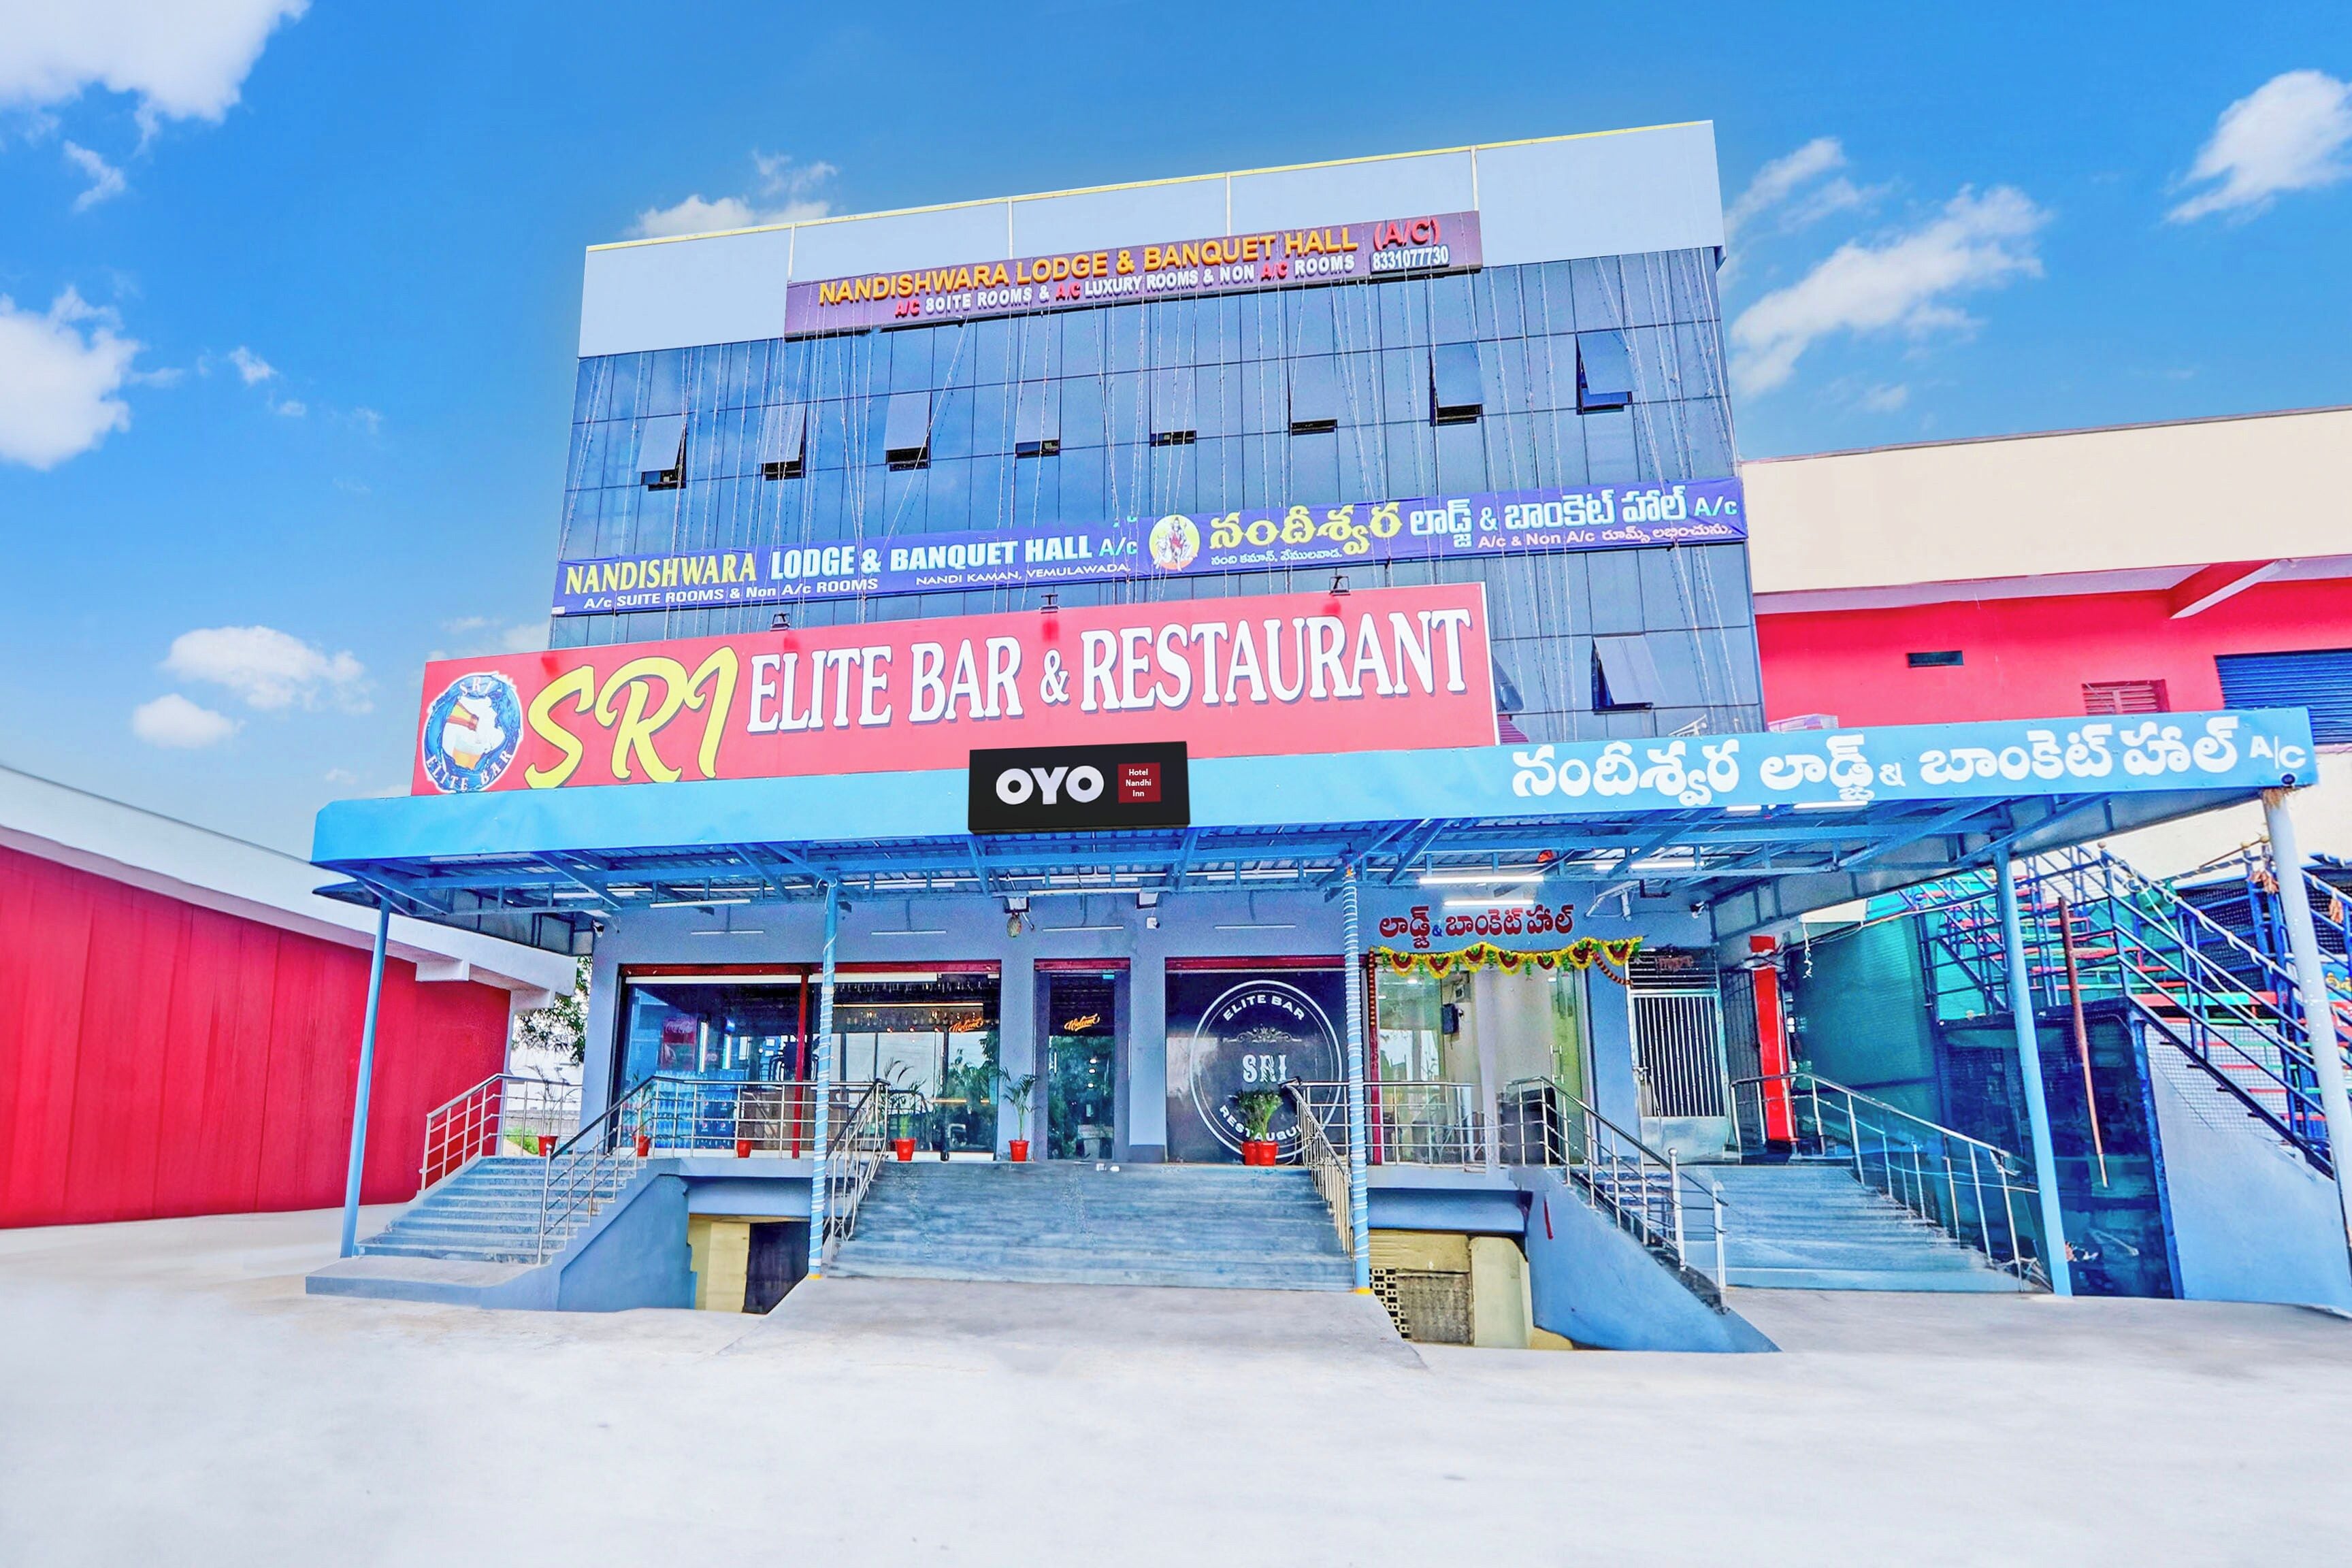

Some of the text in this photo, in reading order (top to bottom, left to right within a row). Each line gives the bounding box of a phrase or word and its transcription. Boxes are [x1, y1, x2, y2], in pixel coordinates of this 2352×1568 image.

[819, 218, 1441, 305] NANDISHWARA LODGE & BANQUET HALL (A/C)
[1373, 244, 1449, 271] 8331077730
[895, 300, 920, 318] A/C
[977, 283, 1032, 308] ROOMS
[1039, 282, 1049, 301] &
[1055, 281, 1081, 301] A/C
[1084, 274, 1143, 297] LUXURY
[1147, 268, 1198, 291] ROOMS
[1203, 267, 1214, 285] &
[1220, 263, 1254, 284] NON
[1261, 260, 1288, 280] A/C
[1294, 255, 1355, 278] ROOMS
[1209, 502, 1403, 555] నందీశ్వర
[1480, 506, 1499, 532] &
[1504, 489, 1616, 530] బాంకెట్
[1622, 485, 1688, 523] హాల్
[1693, 496, 1737, 517] A/c
[1477, 534, 1507, 549] A/c
[1510, 536, 1522, 546] &
[1526, 533, 1562, 546] Non
[1566, 529, 1595, 544] A/c
[565, 535, 1138, 595] NANDISHWARA LODGE & BANQUET HALL A/c
[916, 563, 1132, 586] NANDI KAMAN, VEMULAWADA.
[583, 577, 879, 609] A/c SUITE ROOMS & Non A/c ROOMS
[524, 608, 1472, 789] SRI ELITE BAR & RESTAURANT
[426, 750, 512, 791] ELITE BAR
[1512, 738, 1740, 806] నందీశ్వర
[1919, 723, 2112, 785] బాంకెట్
[2120, 715, 2239, 776] హాల్
[996, 766, 1105, 805] OYO
[1432, 924, 1443, 937] &
[1445, 907, 1524, 936] బాంకెట్
[1526, 904, 1575, 934] హాల్
[1223, 994, 1305, 1021] ELITE BAR
[1243, 1054, 1287, 1083] SRI
